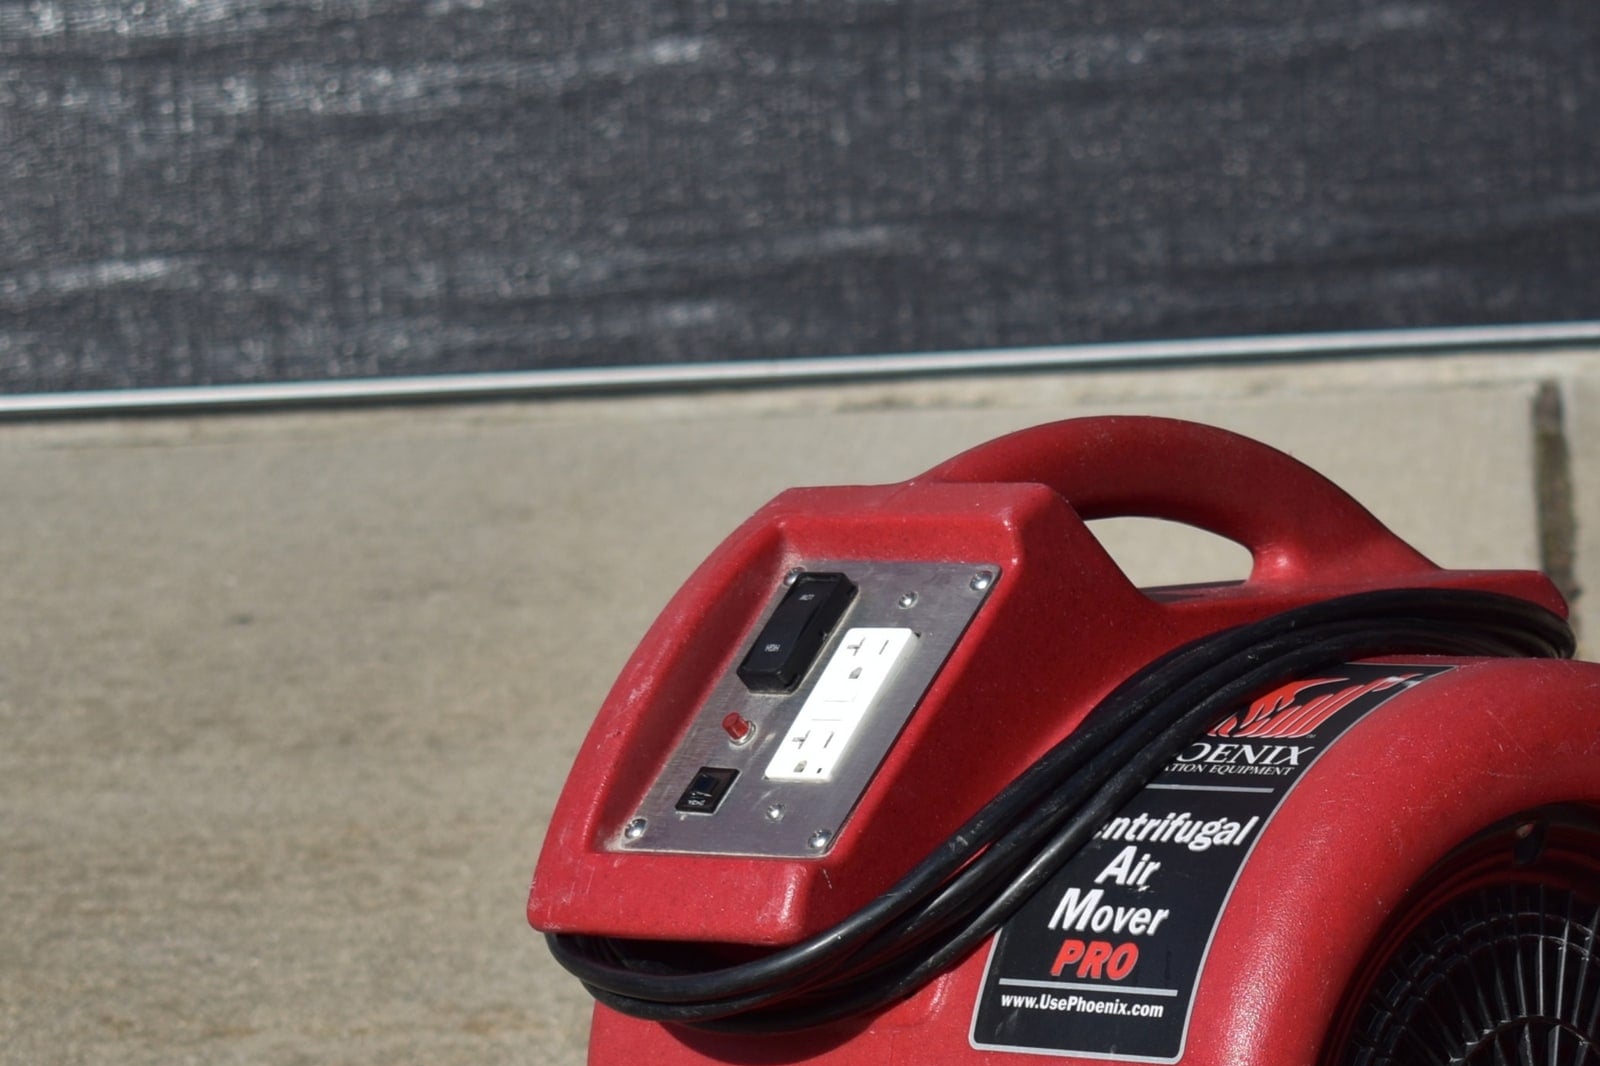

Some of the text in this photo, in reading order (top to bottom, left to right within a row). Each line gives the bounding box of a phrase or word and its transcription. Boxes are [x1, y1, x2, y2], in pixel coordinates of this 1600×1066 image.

[1175, 742, 1315, 766] OENIX
[1209, 765, 1296, 777] EQUIPMENT
[1092, 812, 1260, 851] ntrifugal
[1093, 845, 1162, 886] Air
[1047, 888, 1169, 936] Mover
[1049, 939, 1140, 981] PRO
[1000, 992, 1165, 1019] www.UsePhoenix.com
